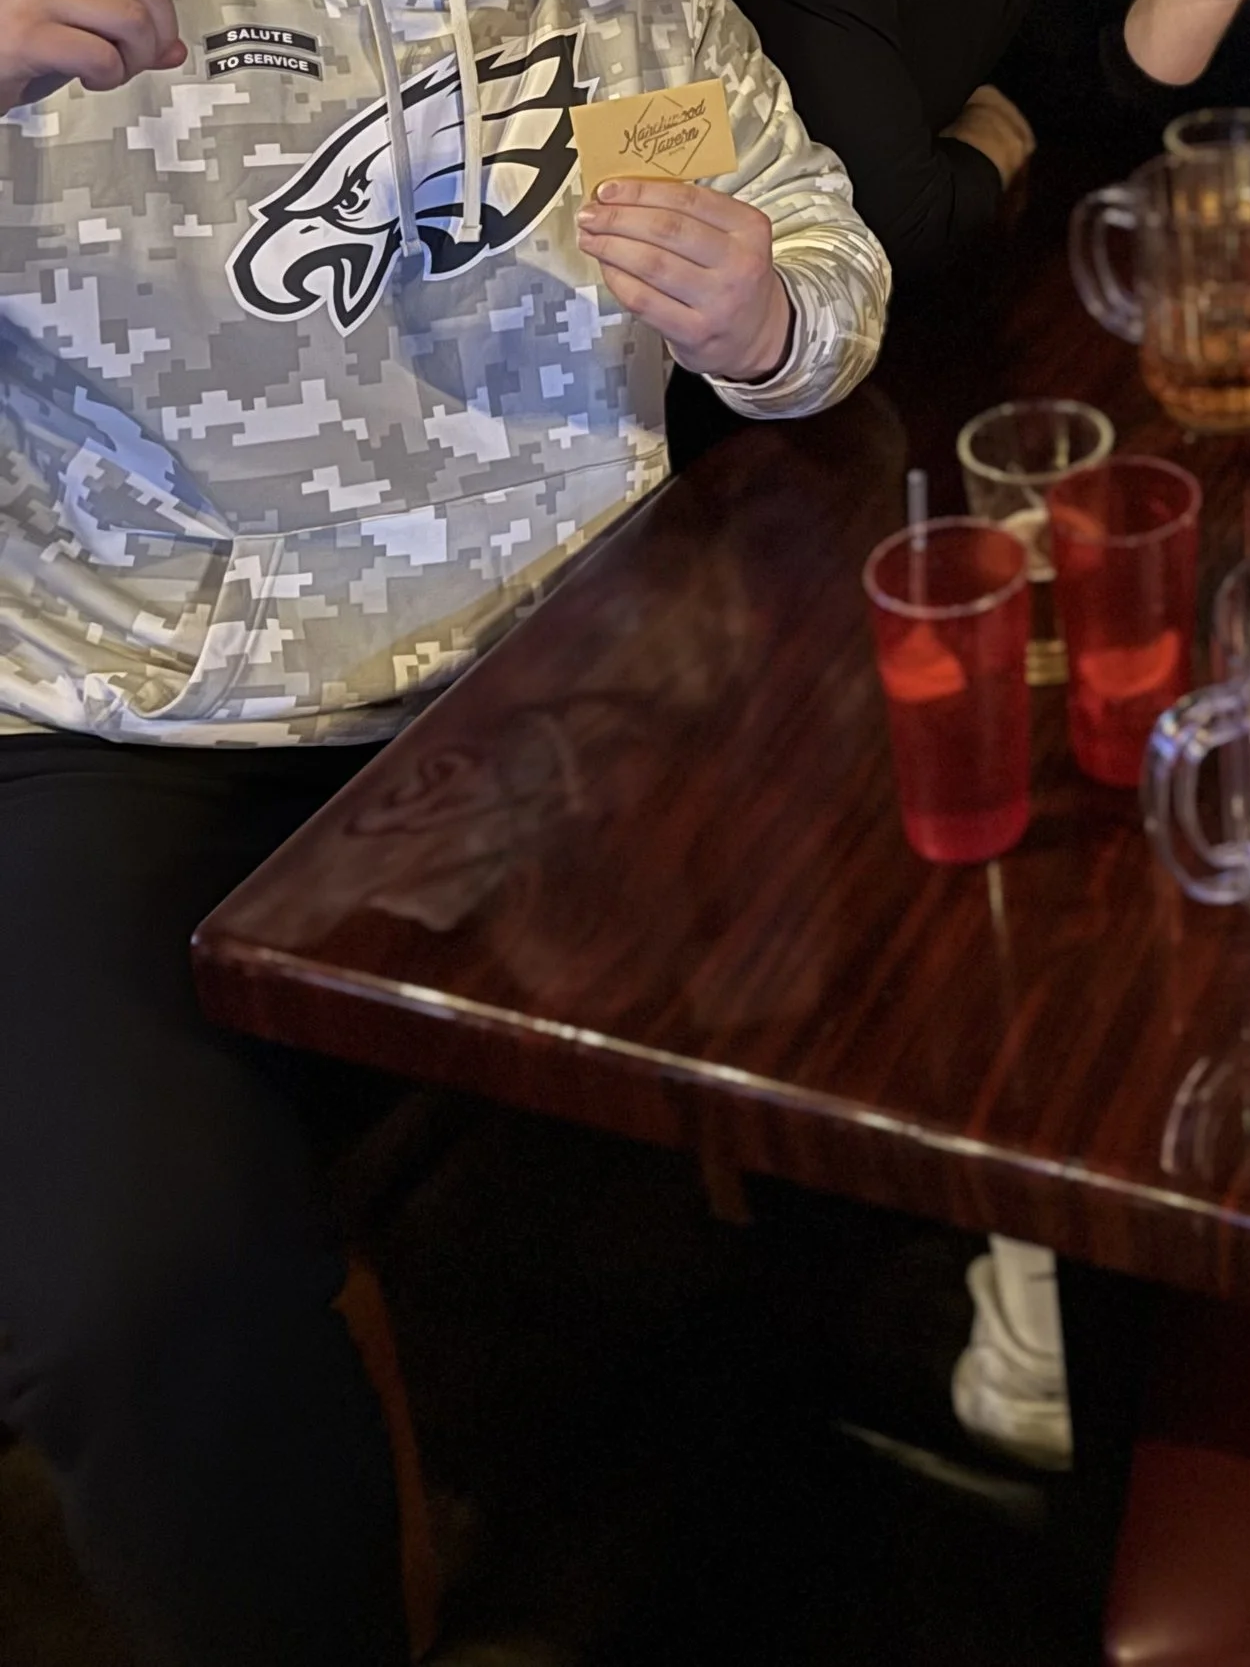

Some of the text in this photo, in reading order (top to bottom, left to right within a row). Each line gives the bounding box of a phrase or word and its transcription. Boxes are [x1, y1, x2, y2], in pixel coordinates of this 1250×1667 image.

[226, 28, 294, 44] SALUTE
[217, 53, 310, 72] TO SERVICE
[642, 127, 699, 163] Tavern
